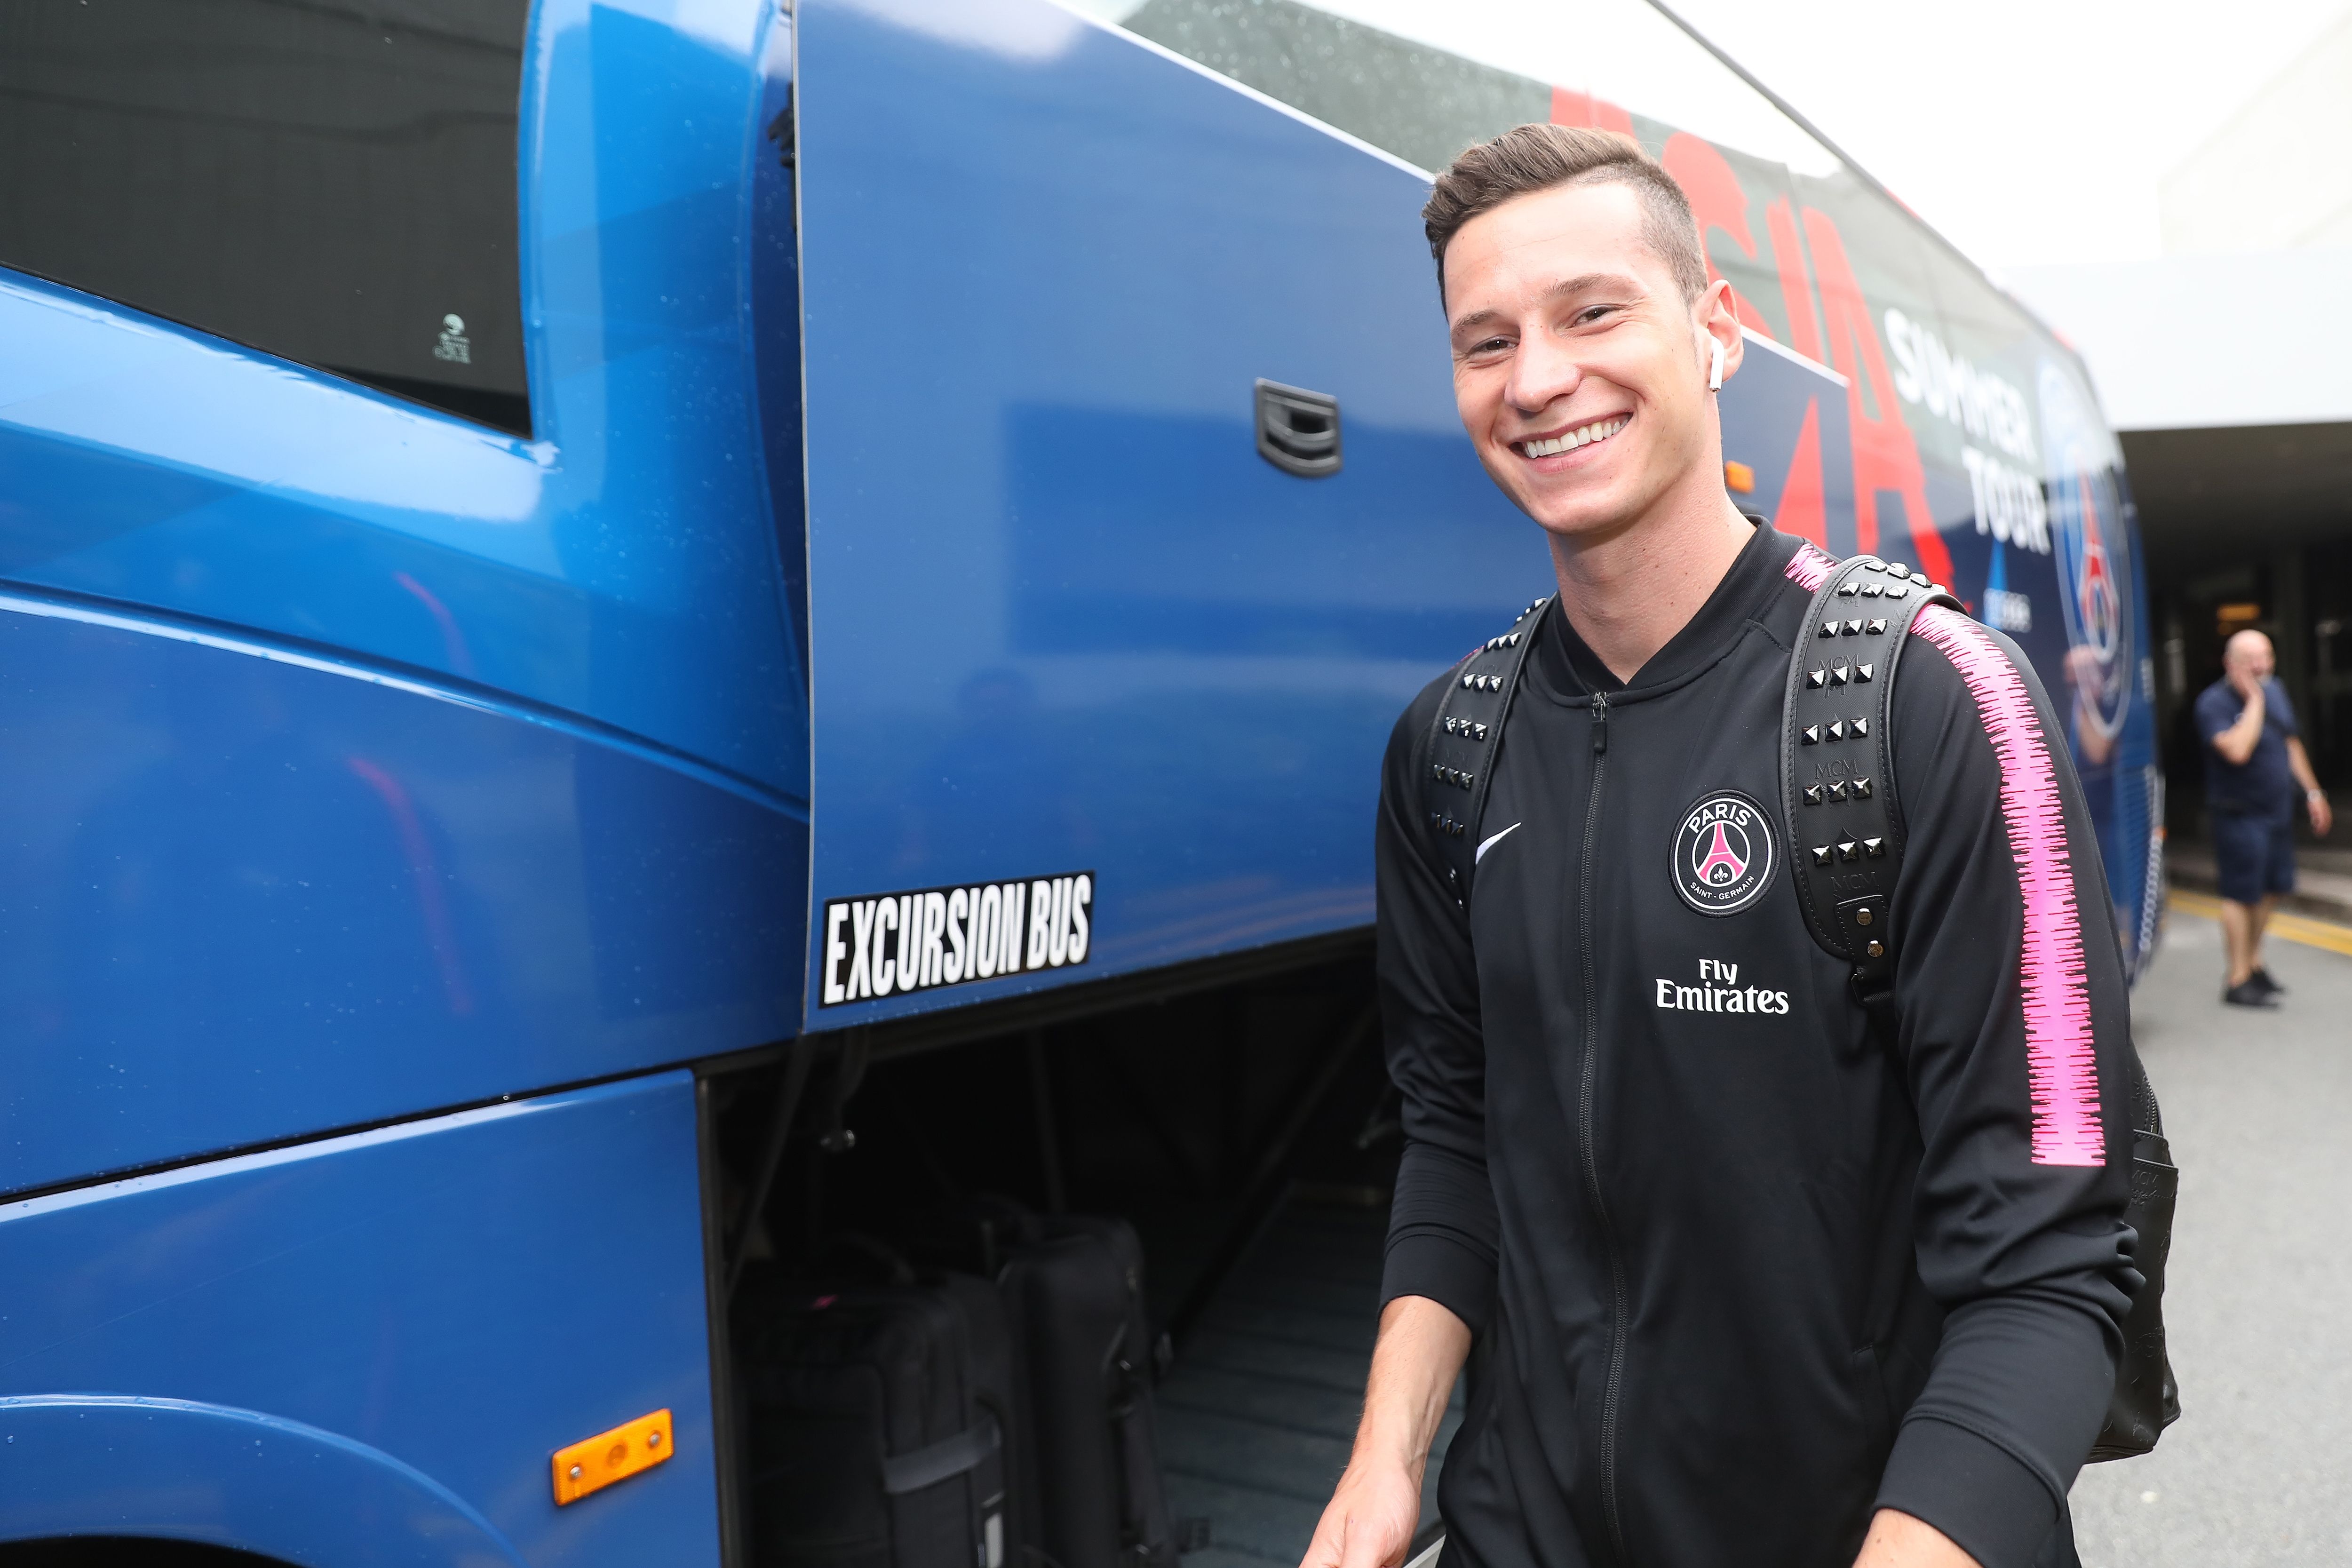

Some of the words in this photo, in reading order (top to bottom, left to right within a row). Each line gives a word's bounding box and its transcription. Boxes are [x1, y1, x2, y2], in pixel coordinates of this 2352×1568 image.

[1961, 445, 2051, 556] TOUR
[1814, 758, 1859, 779] MCM
[1688, 803, 1751, 834] PARIS
[1830, 872, 1879, 892] MCM
[824, 882, 1026, 1004] EXCURSION
[1026, 874, 1091, 969] BUS
[1699, 959, 1738, 985] Fly
[1655, 979, 1789, 1014] Emirates
